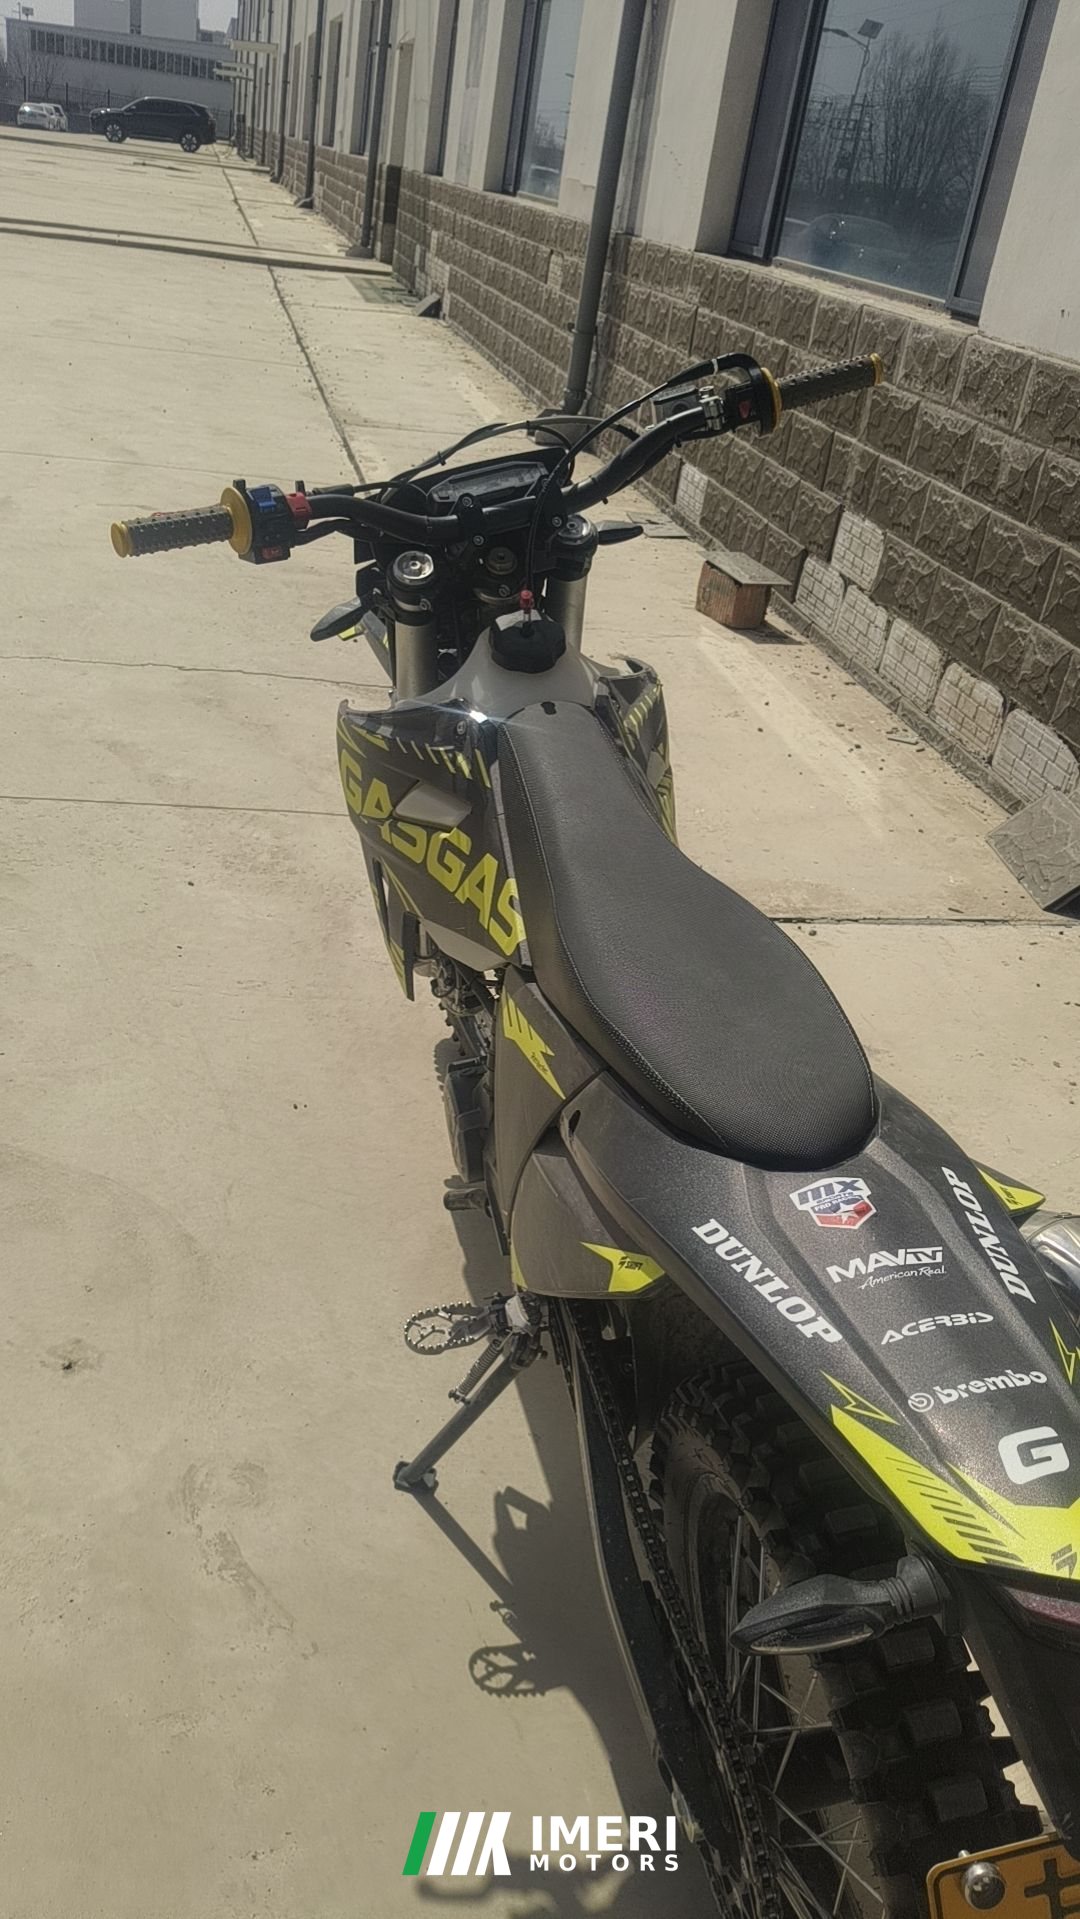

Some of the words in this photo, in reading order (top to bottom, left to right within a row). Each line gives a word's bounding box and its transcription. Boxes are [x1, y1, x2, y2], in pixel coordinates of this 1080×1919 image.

[941, 1166, 1036, 1304] DUNLOP
[692, 1218, 844, 1343] DUNLOP
[857, 1269, 918, 1290] American
[934, 1369, 1048, 1405] brembo
[998, 1426, 1070, 1485] G
